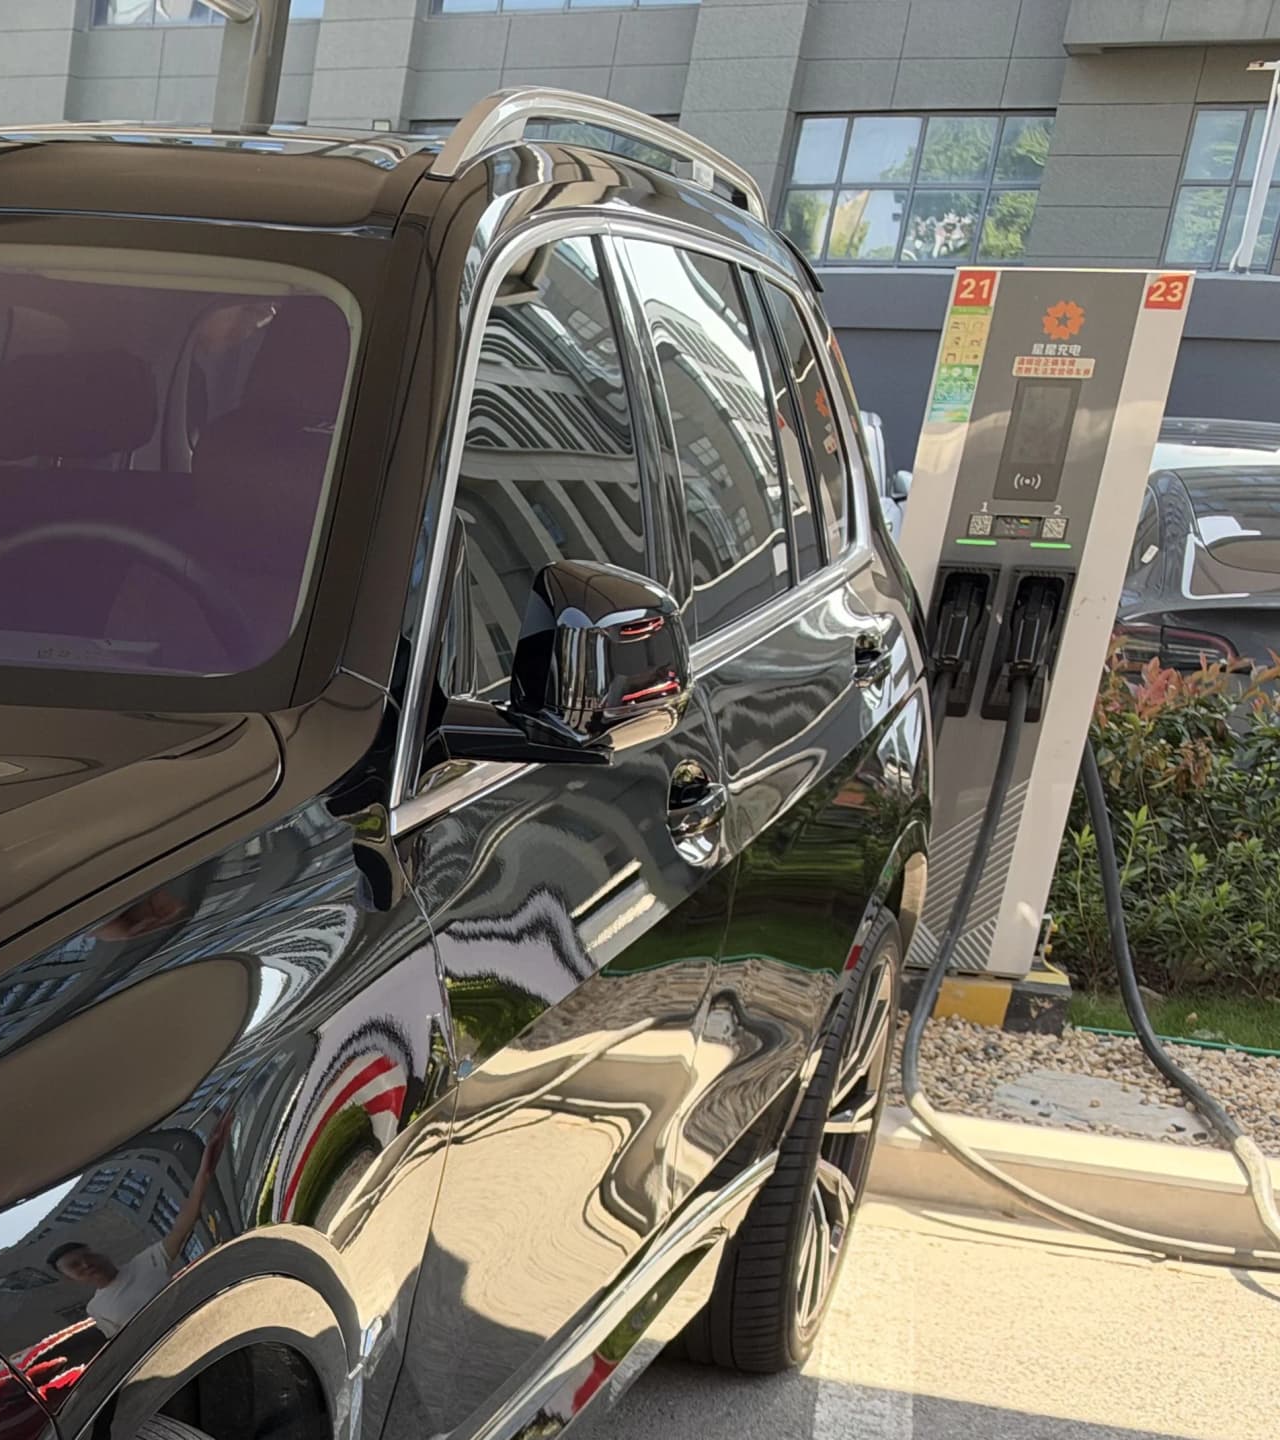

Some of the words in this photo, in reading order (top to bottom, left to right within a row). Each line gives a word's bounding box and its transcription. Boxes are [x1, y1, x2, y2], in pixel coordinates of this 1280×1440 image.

[959, 278, 992, 299] 21
[1149, 281, 1184, 302] 23
[980, 501, 988, 513] 1
[1053, 504, 1063, 516] 2
